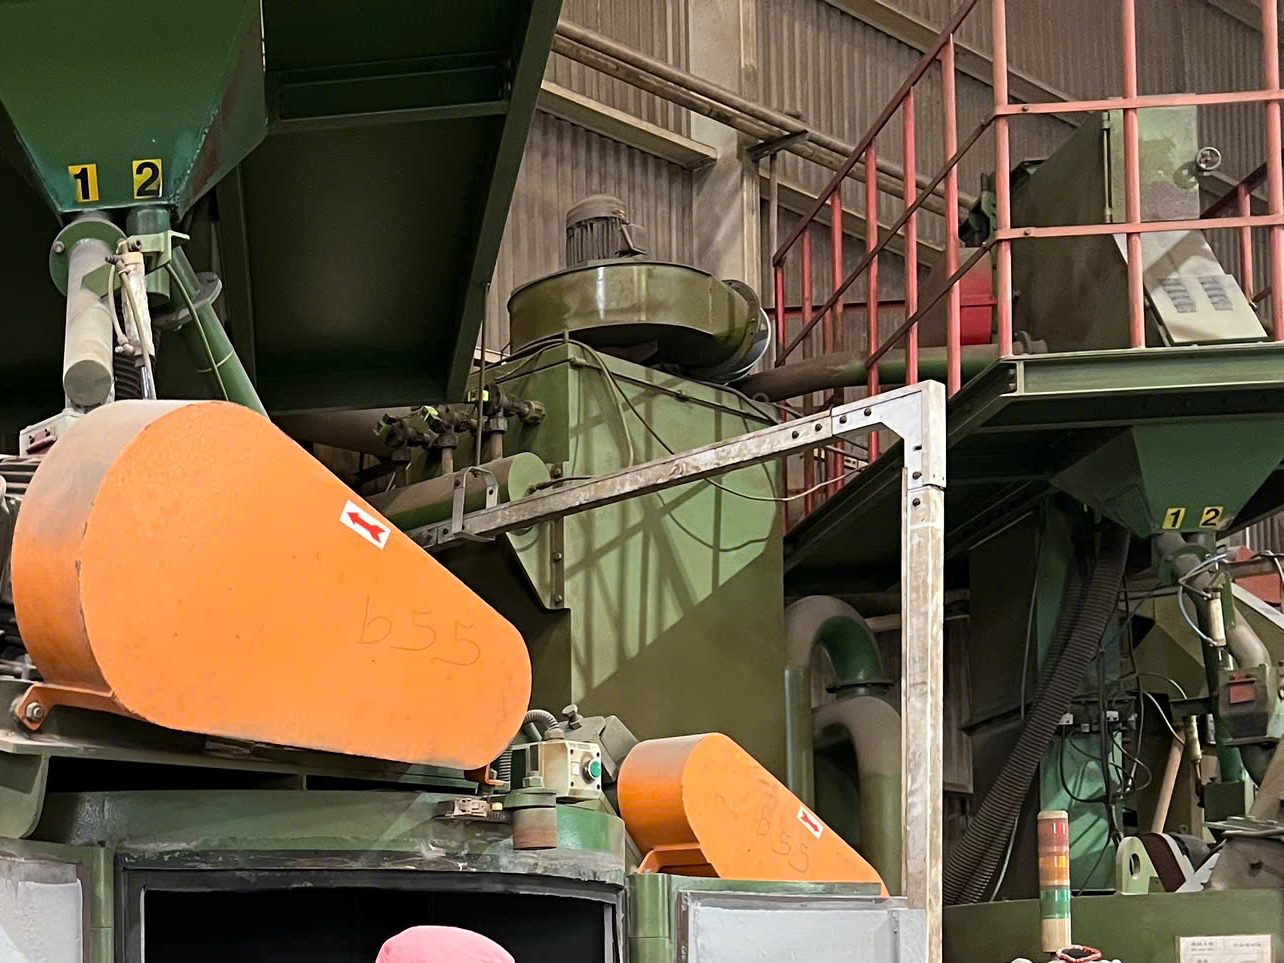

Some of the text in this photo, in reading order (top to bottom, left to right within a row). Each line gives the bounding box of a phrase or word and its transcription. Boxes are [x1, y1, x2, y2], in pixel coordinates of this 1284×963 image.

[74, 161, 160, 200] 1 2
[1170, 508, 1220, 528] 1 2
